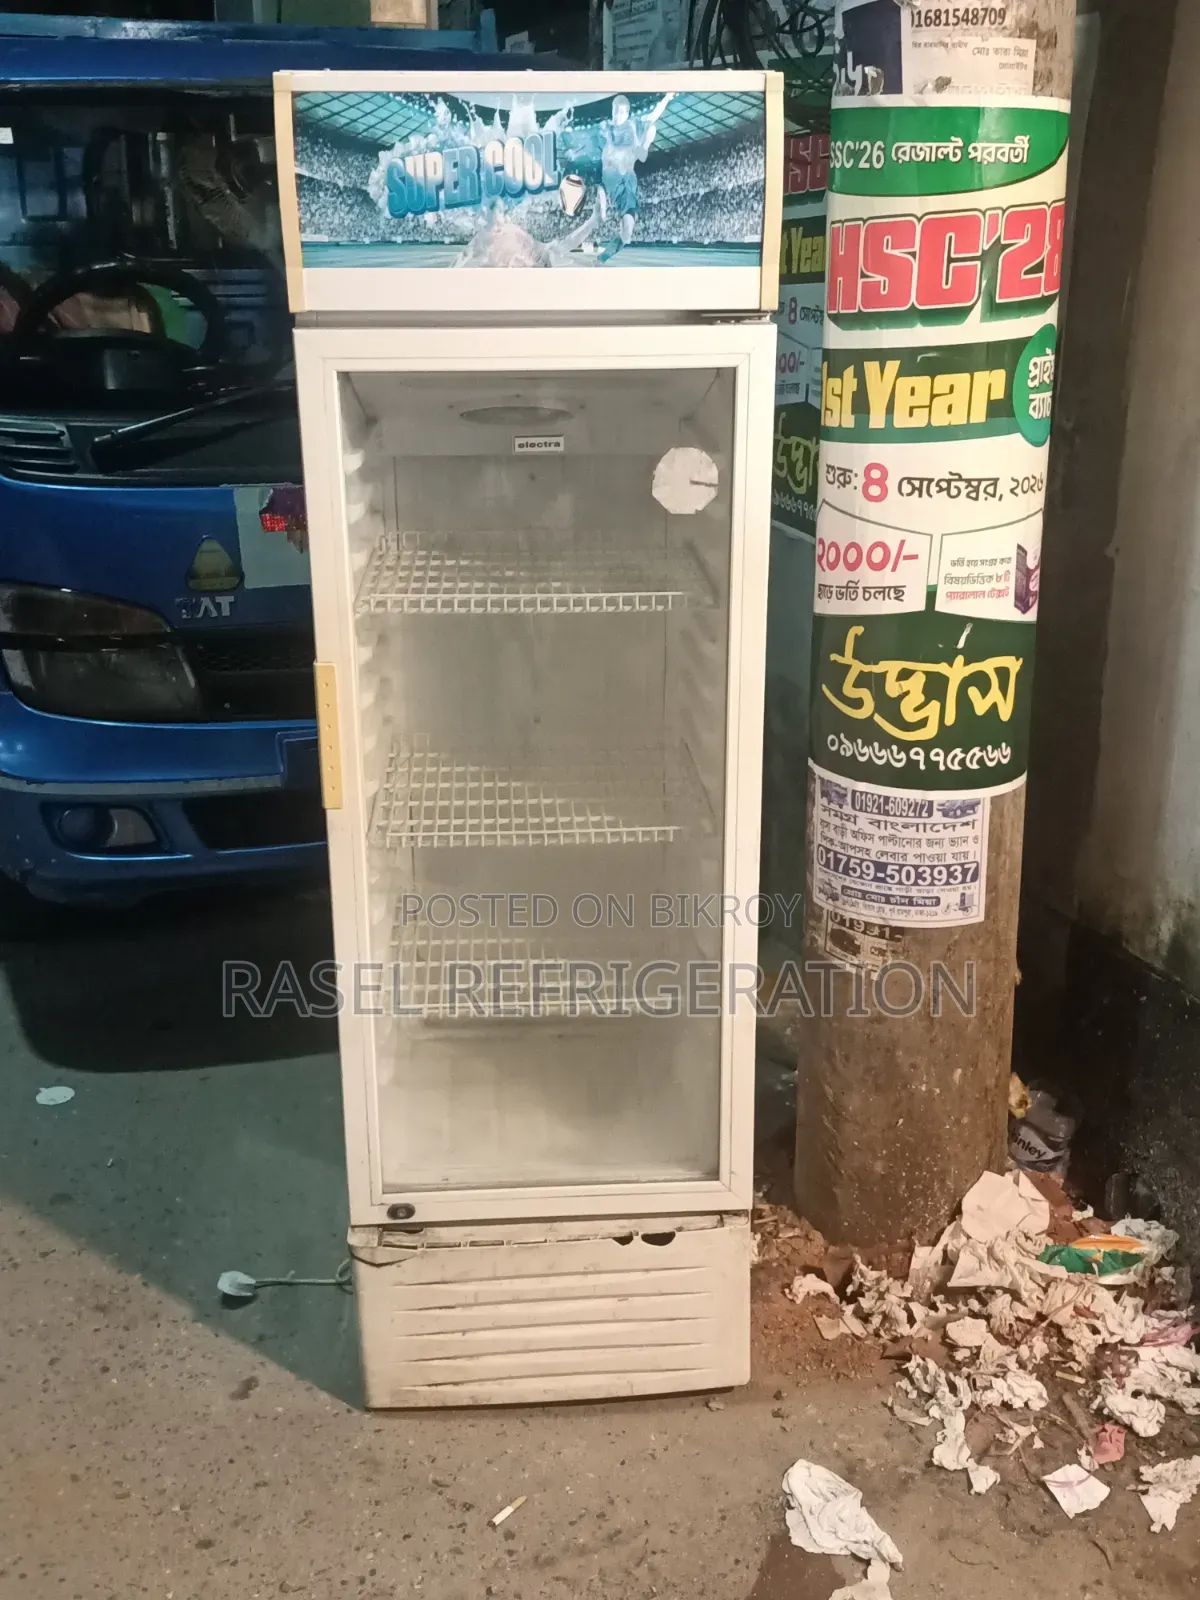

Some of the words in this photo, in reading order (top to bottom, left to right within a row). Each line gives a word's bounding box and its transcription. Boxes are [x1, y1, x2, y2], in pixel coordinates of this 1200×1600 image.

[891, 137, 963, 164] রেজাল্ট
[968, 135, 1031, 164] পরবর্তী
[384, 145, 483, 218] SUPER
[483, 130, 560, 198] COOL
[864, 360, 1006, 429] Year
[517, 440, 562, 449] electra
[835, 579, 860, 601] ভর্তি
[862, 584, 907, 602] চলছে
[855, 791, 929, 817] 01921-609272
[865, 818, 979, 833] বাংলাদেশ
[817, 846, 978, 886] 01759-503937
